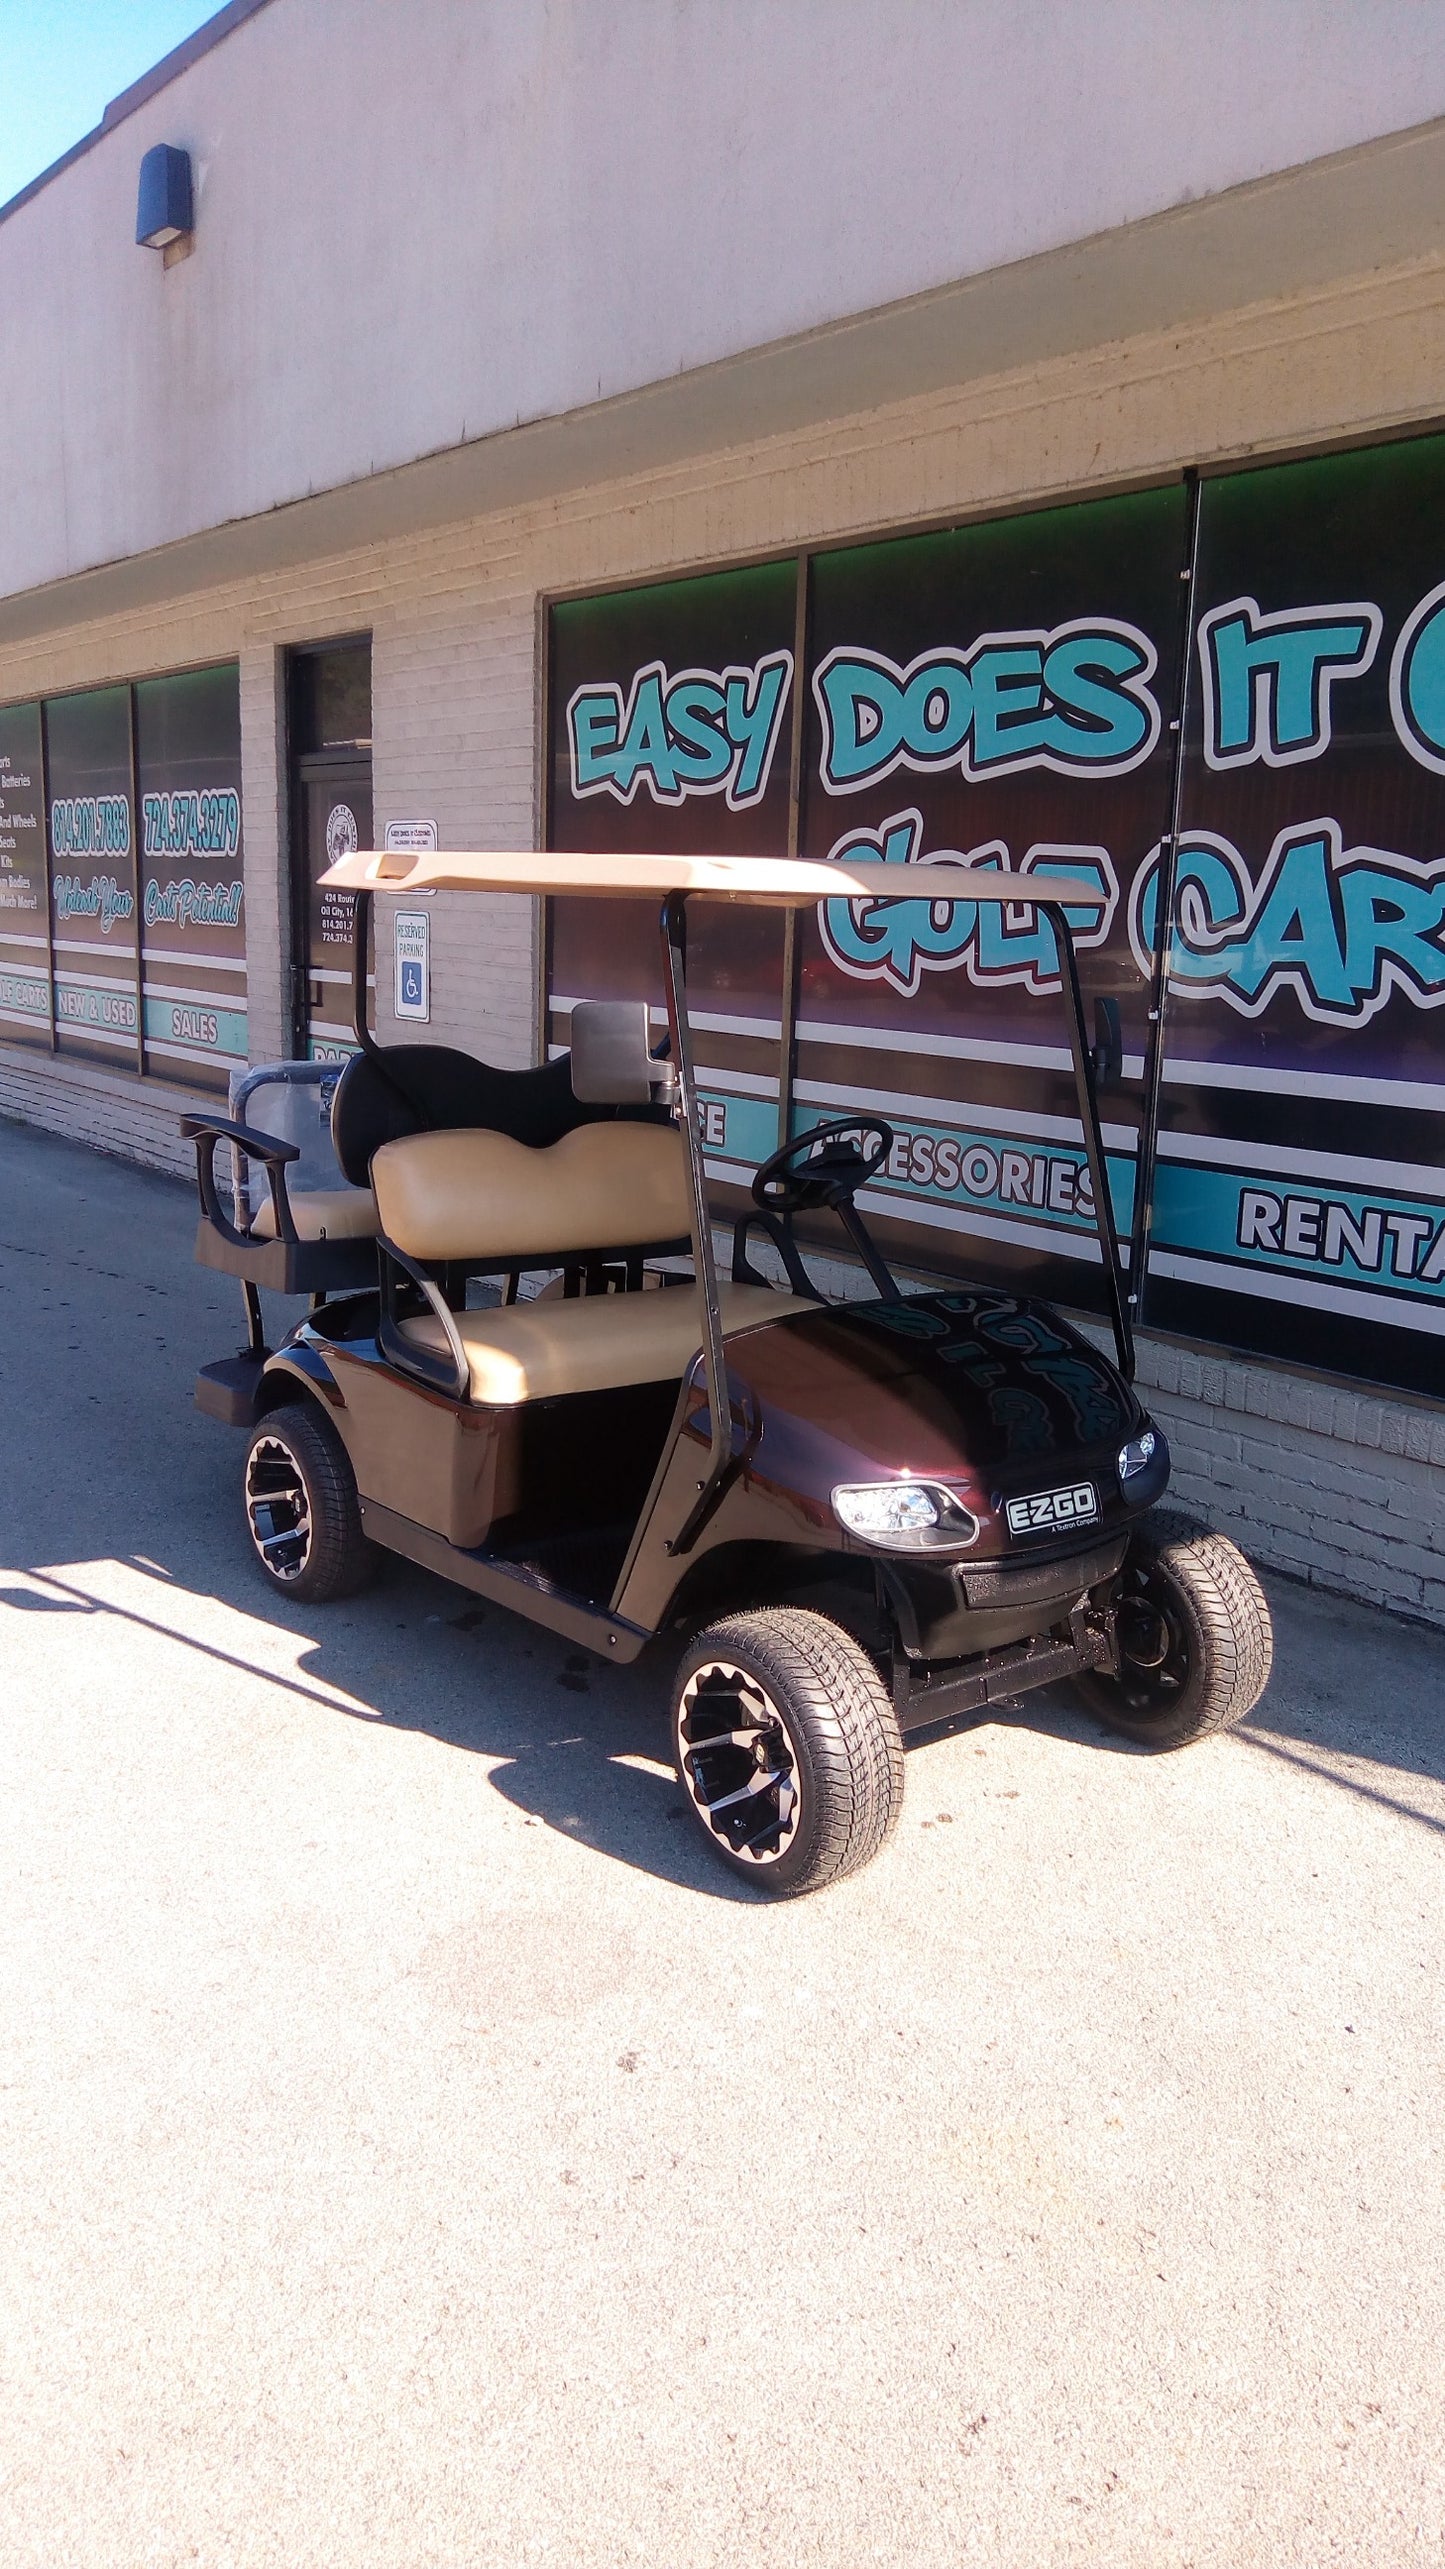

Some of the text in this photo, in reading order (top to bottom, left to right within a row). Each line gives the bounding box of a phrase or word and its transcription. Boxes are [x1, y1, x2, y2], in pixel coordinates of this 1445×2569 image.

[566, 649, 795, 813] EASY
[812, 616, 1161, 797] DOES
[1197, 596, 1383, 771] IT
[1, 773, 31, 788] Batteries
[12, 813, 37, 829] Wheels
[52, 794, 130, 857] 814.201.7883
[143, 788, 240, 857] 724.374.3279
[9, 874, 31, 889] Bodies
[17, 894, 38, 910] More!
[98, 875, 134, 934] Your
[144, 878, 179, 927] Carts
[324, 892, 337, 903] 424
[331, 906, 345, 919] City,
[817, 807, 1445, 1030] GOLF CAR
[397, 923, 426, 940] RESERVED
[399, 942, 424, 958] PARKING
[0, 979, 48, 1011] LF CARTS
[57, 987, 137, 1028] NEW & USED
[172, 1007, 219, 1044] SALES
[1056, 1520, 1077, 1532] Textron
[1075, 1515, 1099, 1527] Company
